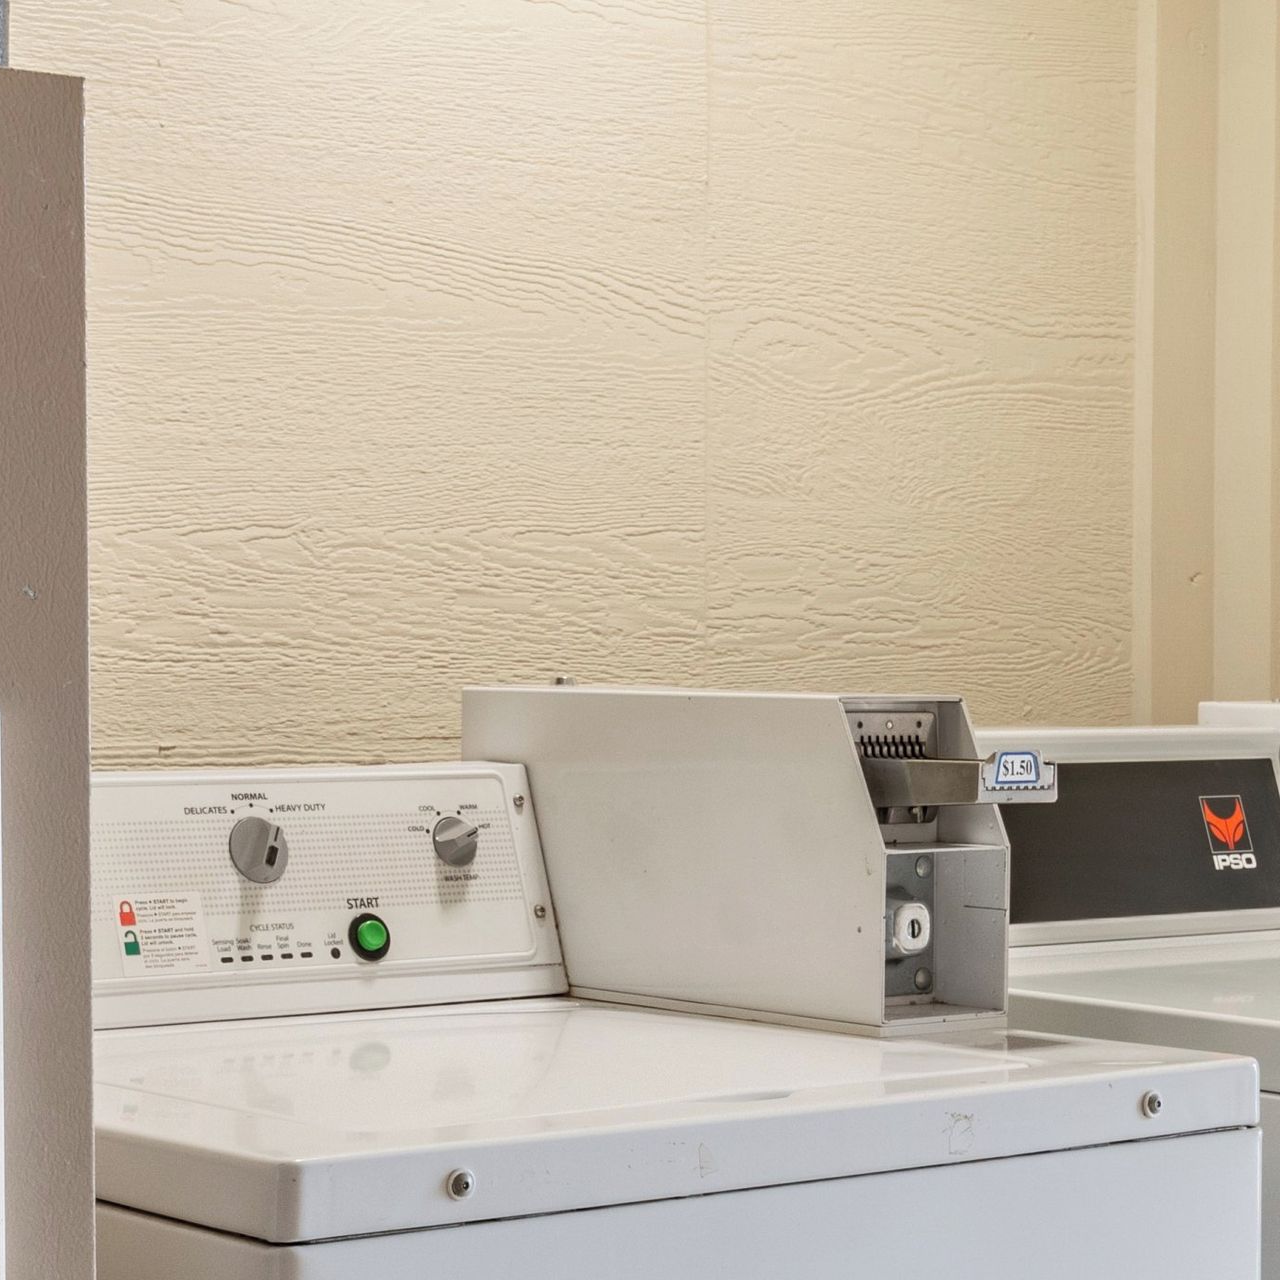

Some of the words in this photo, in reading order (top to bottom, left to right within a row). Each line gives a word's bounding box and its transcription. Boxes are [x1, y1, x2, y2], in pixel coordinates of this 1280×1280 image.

[1002, 759, 1032, 778] $1.50
[184, 806, 227, 815] DELICATES
[275, 804, 301, 812] HEAVY
[304, 804, 325, 812] DUTY
[1213, 853, 1257, 870] IPSO
[347, 897, 379, 909] START
[250, 924, 269, 932] CYCLE
